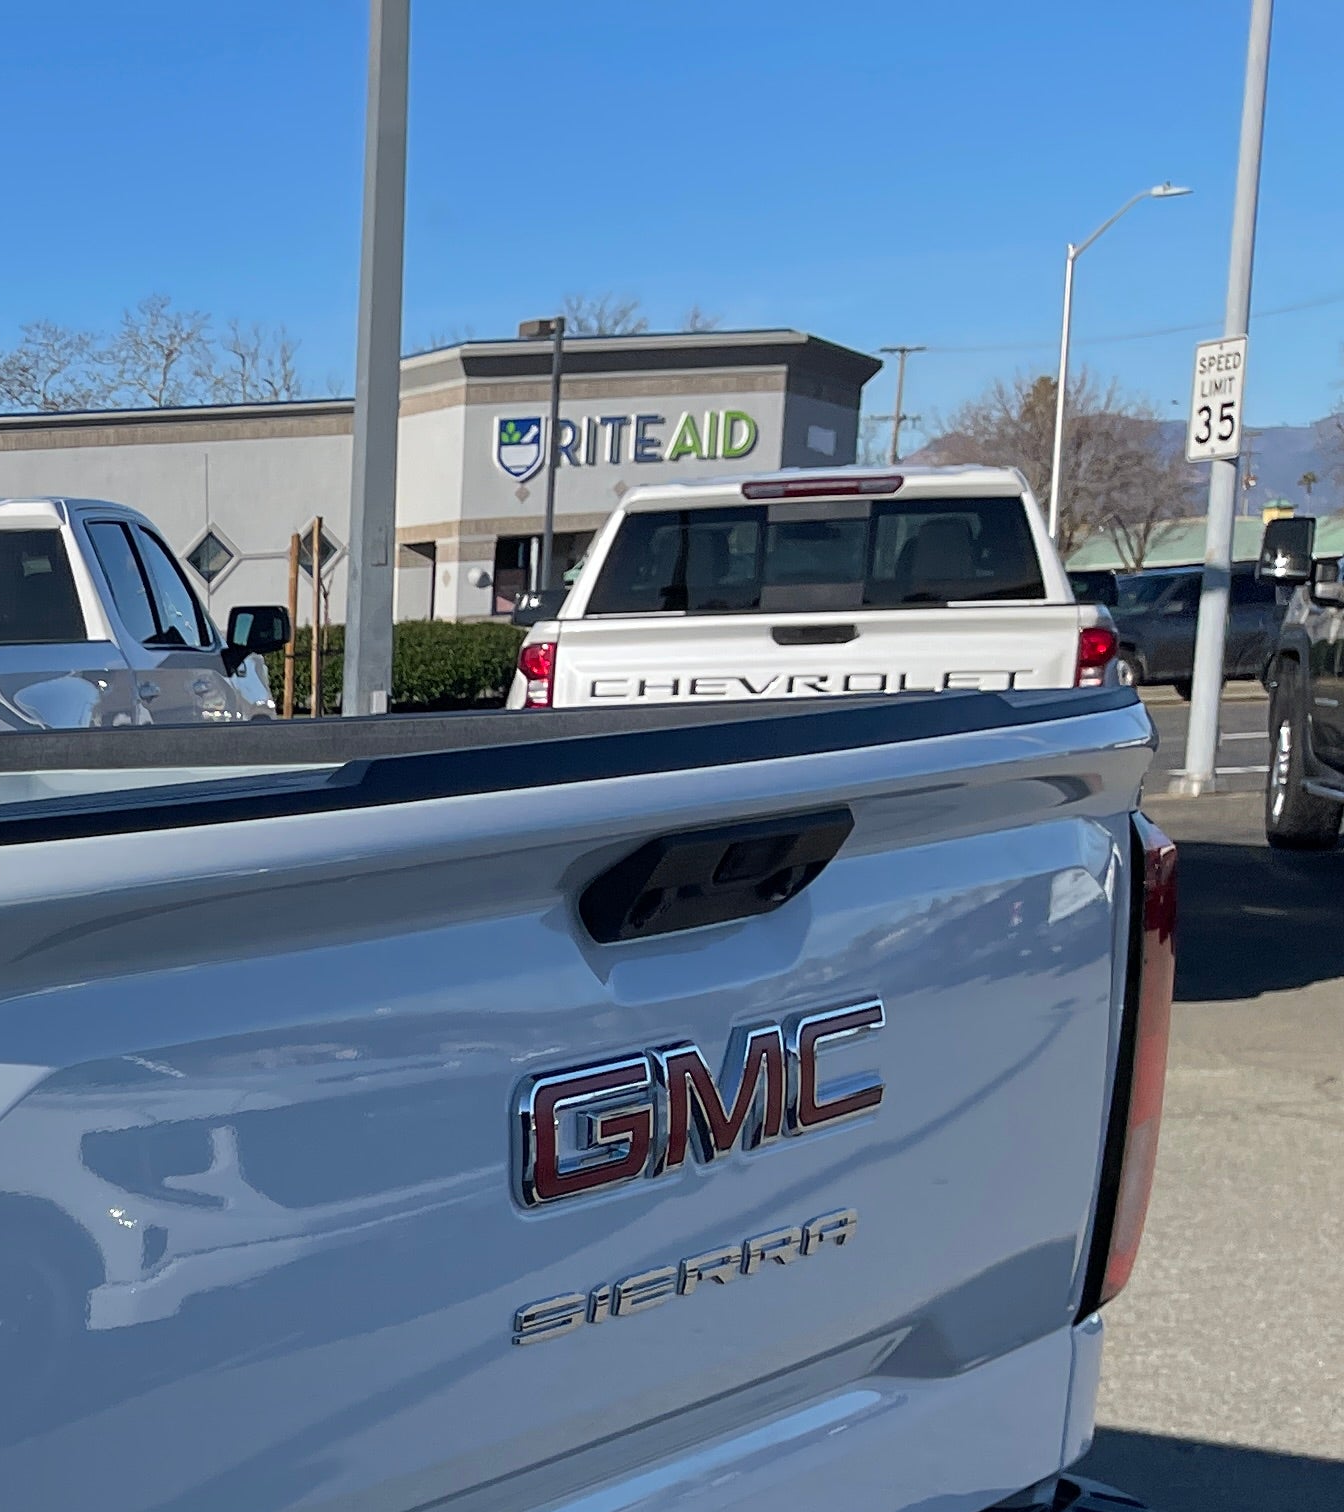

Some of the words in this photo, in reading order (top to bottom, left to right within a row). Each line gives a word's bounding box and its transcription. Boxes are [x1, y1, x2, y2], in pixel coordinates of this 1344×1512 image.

[1198, 352, 1242, 375] SPEED
[1200, 376, 1236, 398] LIMIT
[1194, 401, 1235, 444] 35
[590, 668, 1036, 698] CHEVROLET
[512, 994, 886, 1208] GMC
[512, 1207, 858, 1345] SIERRA
